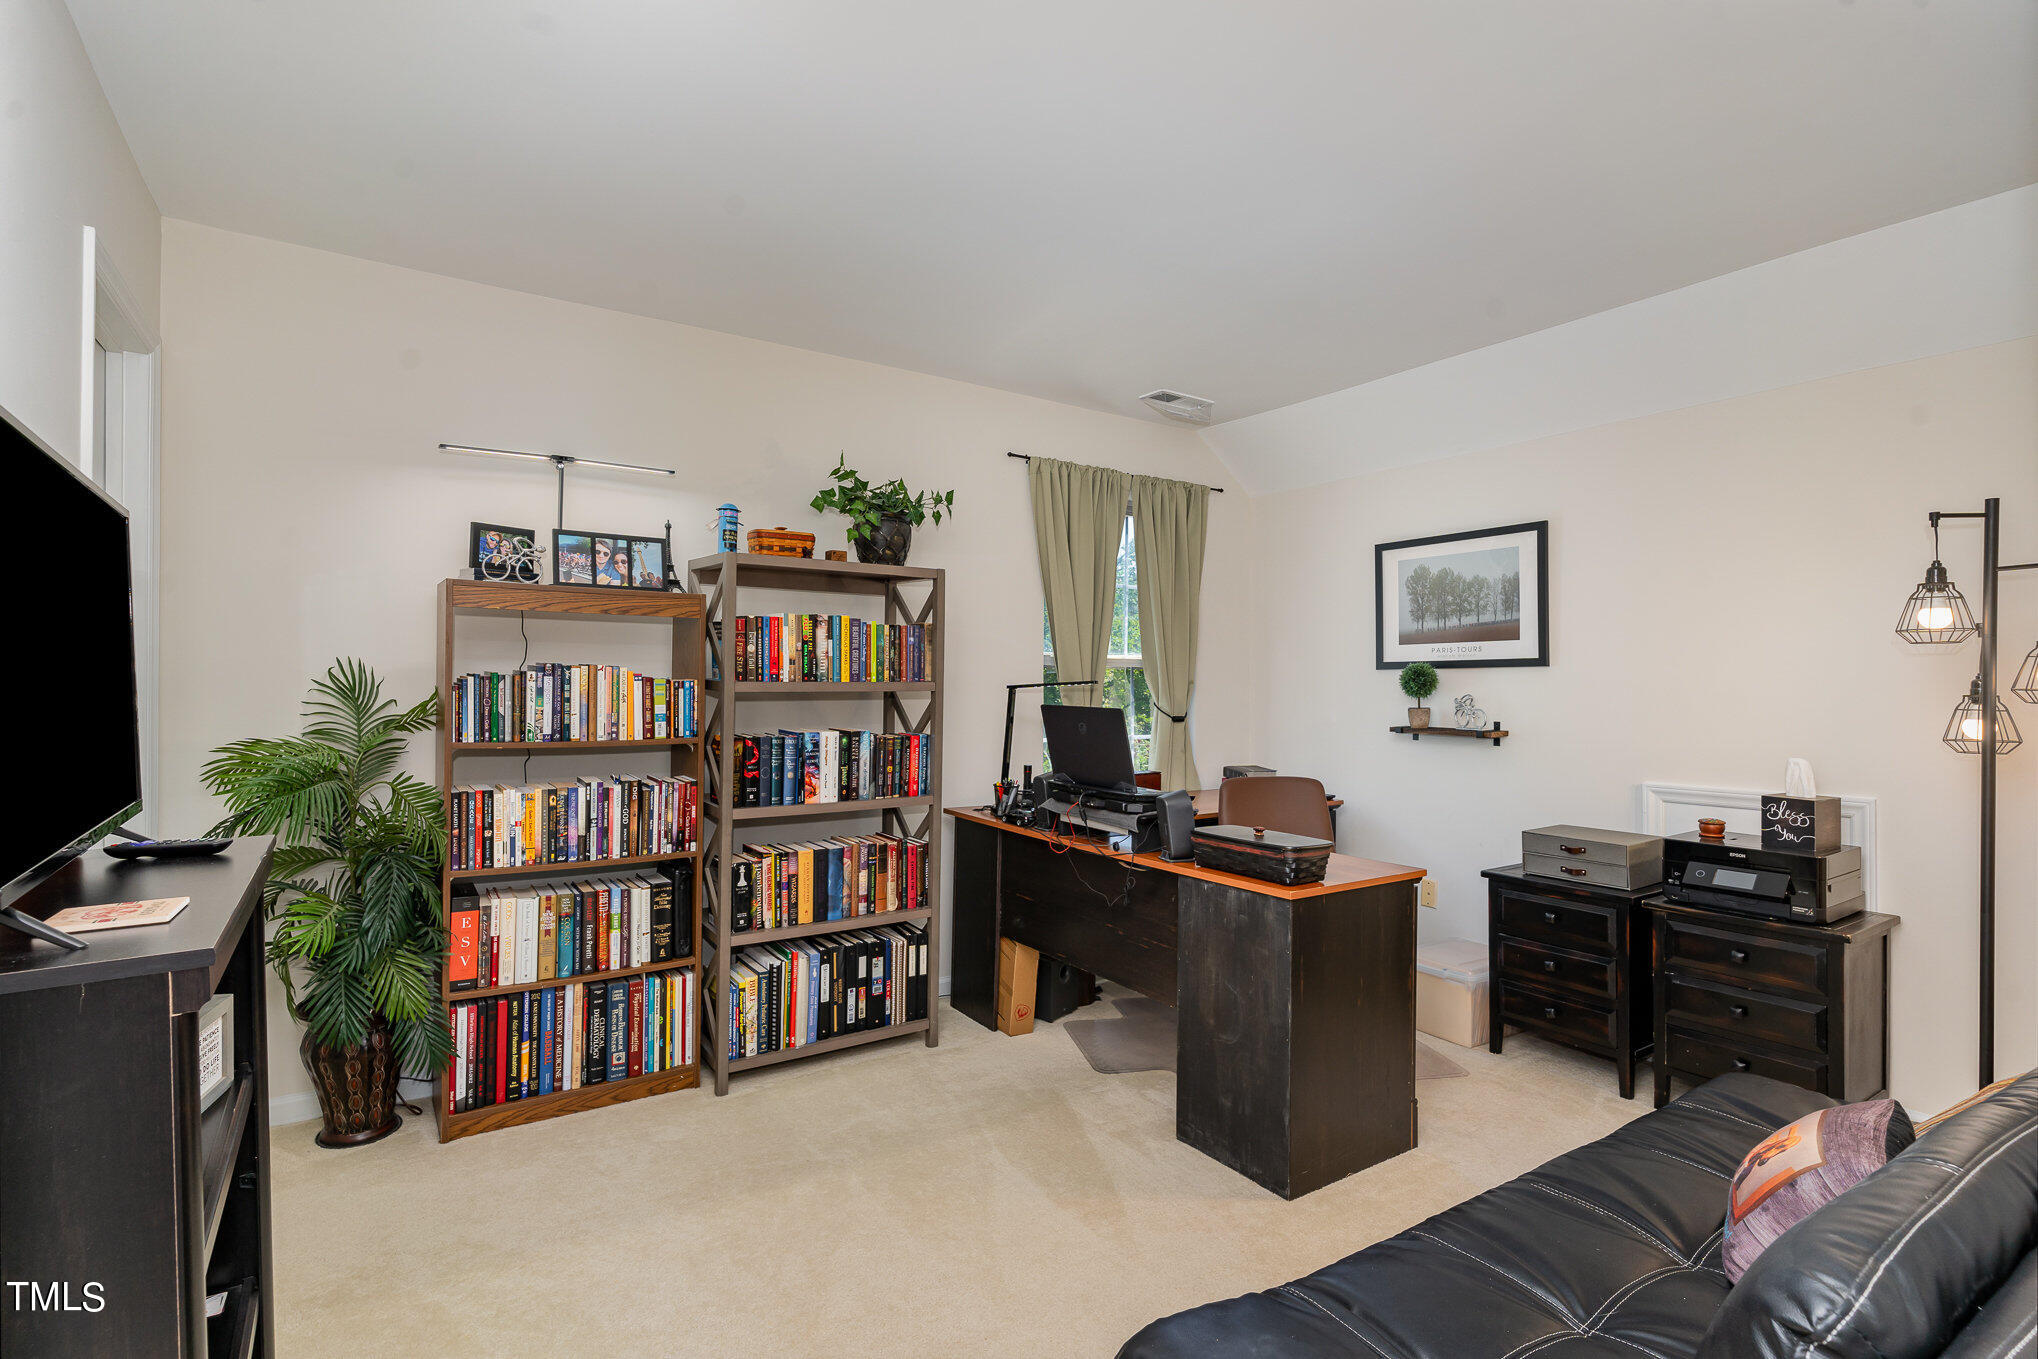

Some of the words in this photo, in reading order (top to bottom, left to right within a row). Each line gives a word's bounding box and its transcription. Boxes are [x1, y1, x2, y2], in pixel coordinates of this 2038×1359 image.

[1763, 800, 1812, 827] Bless
[1769, 824, 1806, 842] You
[202, 1026, 219, 1042] PATIENCE
[555, 1007, 563, 1035] HISTORY
[592, 1009, 600, 1060] DERMATOLOGY
[211, 1053, 219, 1066] LIFE
[544, 1030, 553, 1065] BASEBALL
[510, 1054, 518, 1077] Anatomy
[555, 1044, 563, 1079] MEDICINE
